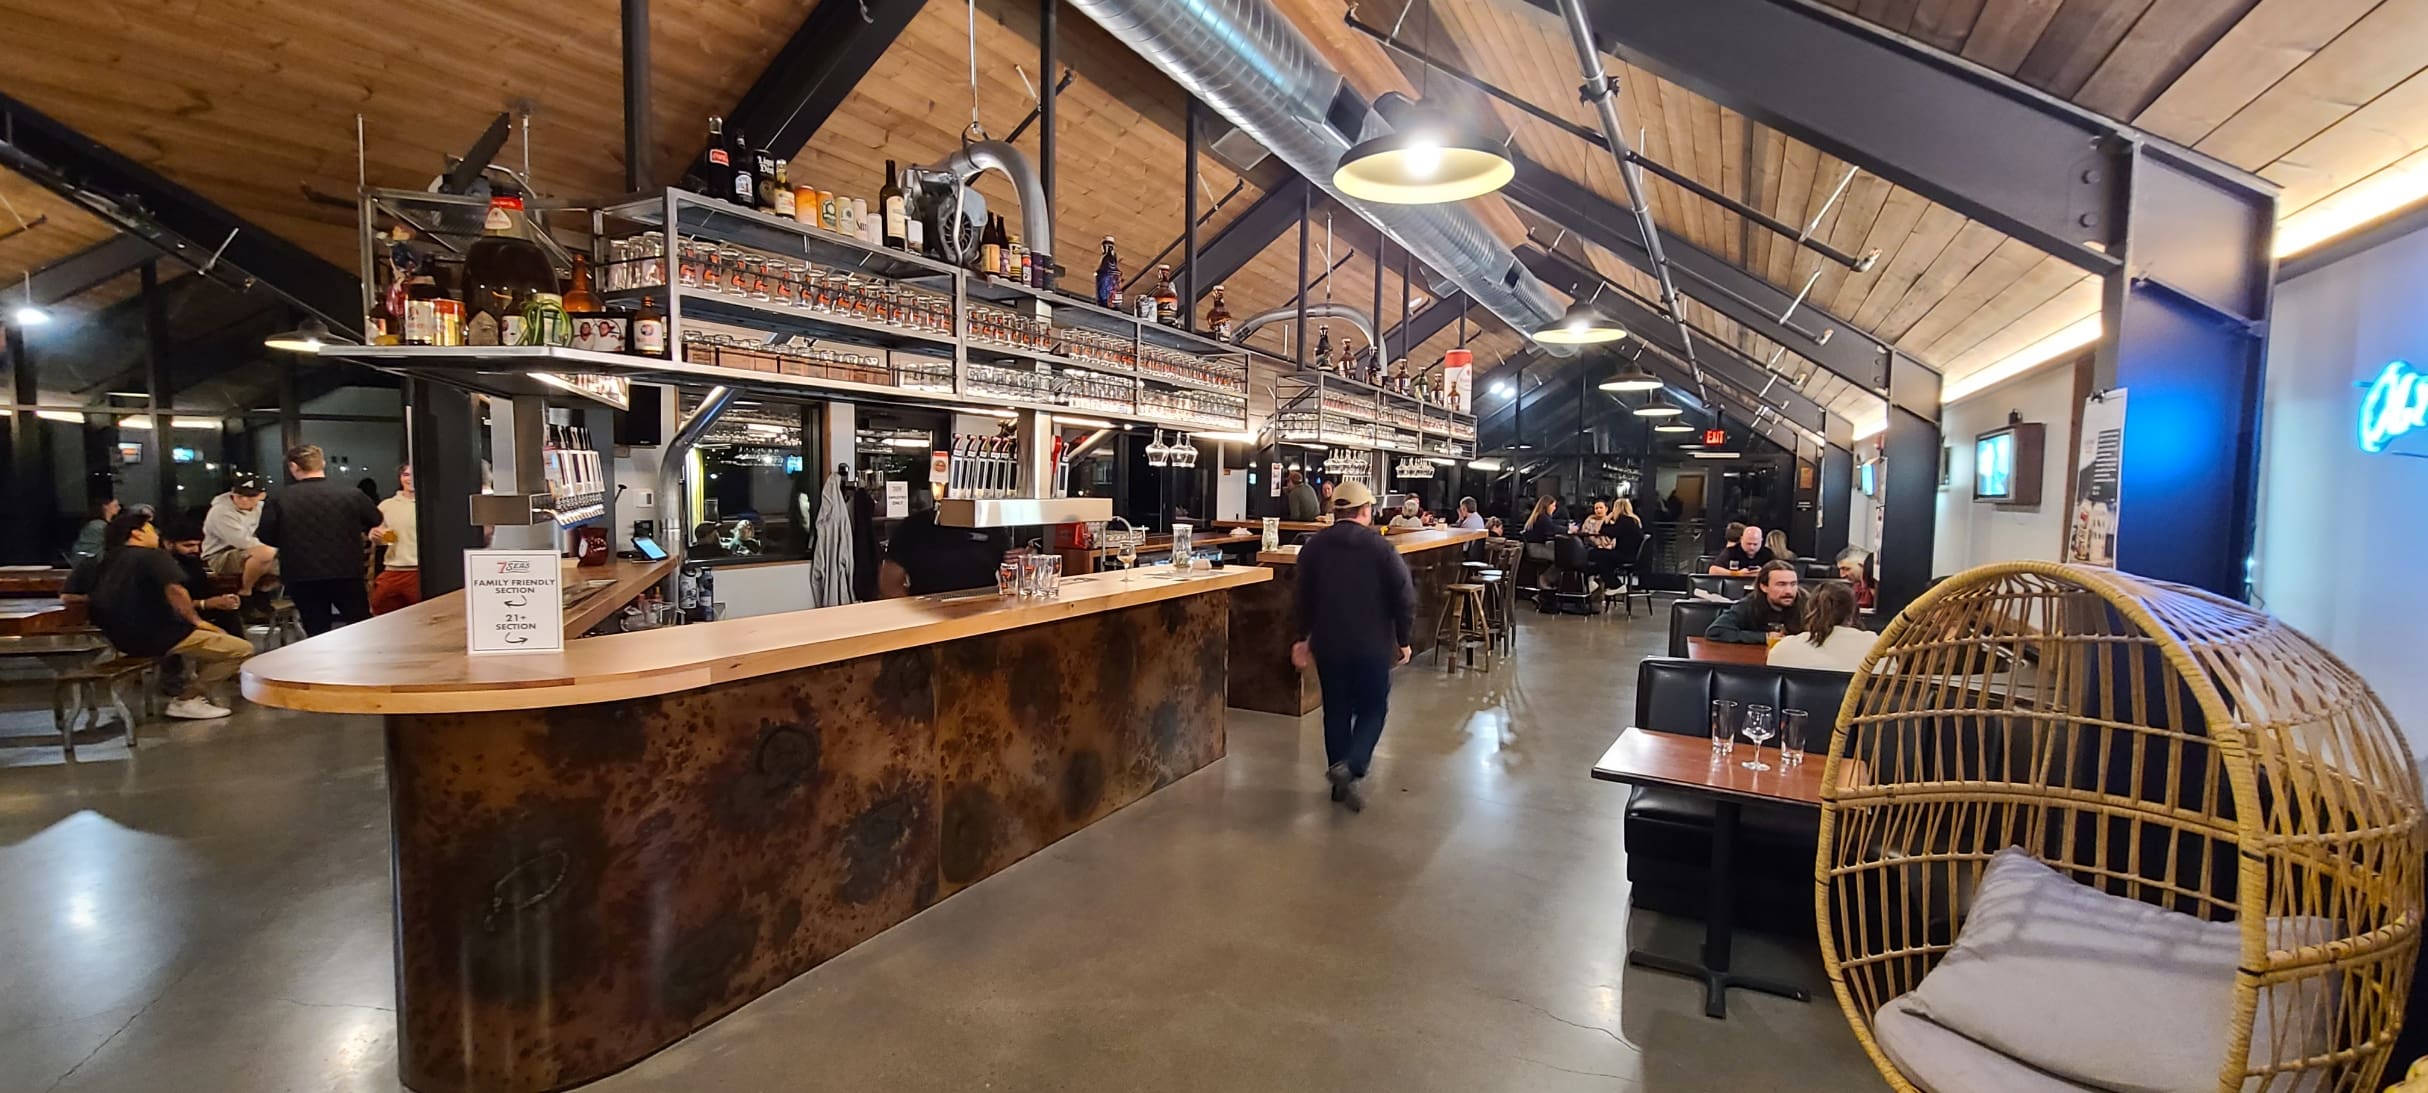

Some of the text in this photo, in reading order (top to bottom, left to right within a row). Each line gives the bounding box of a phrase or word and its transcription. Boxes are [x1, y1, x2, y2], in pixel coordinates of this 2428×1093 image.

[1706, 430, 1725, 444] EXIT
[474, 579, 555, 587] FAMILY FRIENDLY
[495, 586, 535, 594] SECTION
[505, 614, 527, 622] 21+
[495, 623, 537, 631] SECTION
